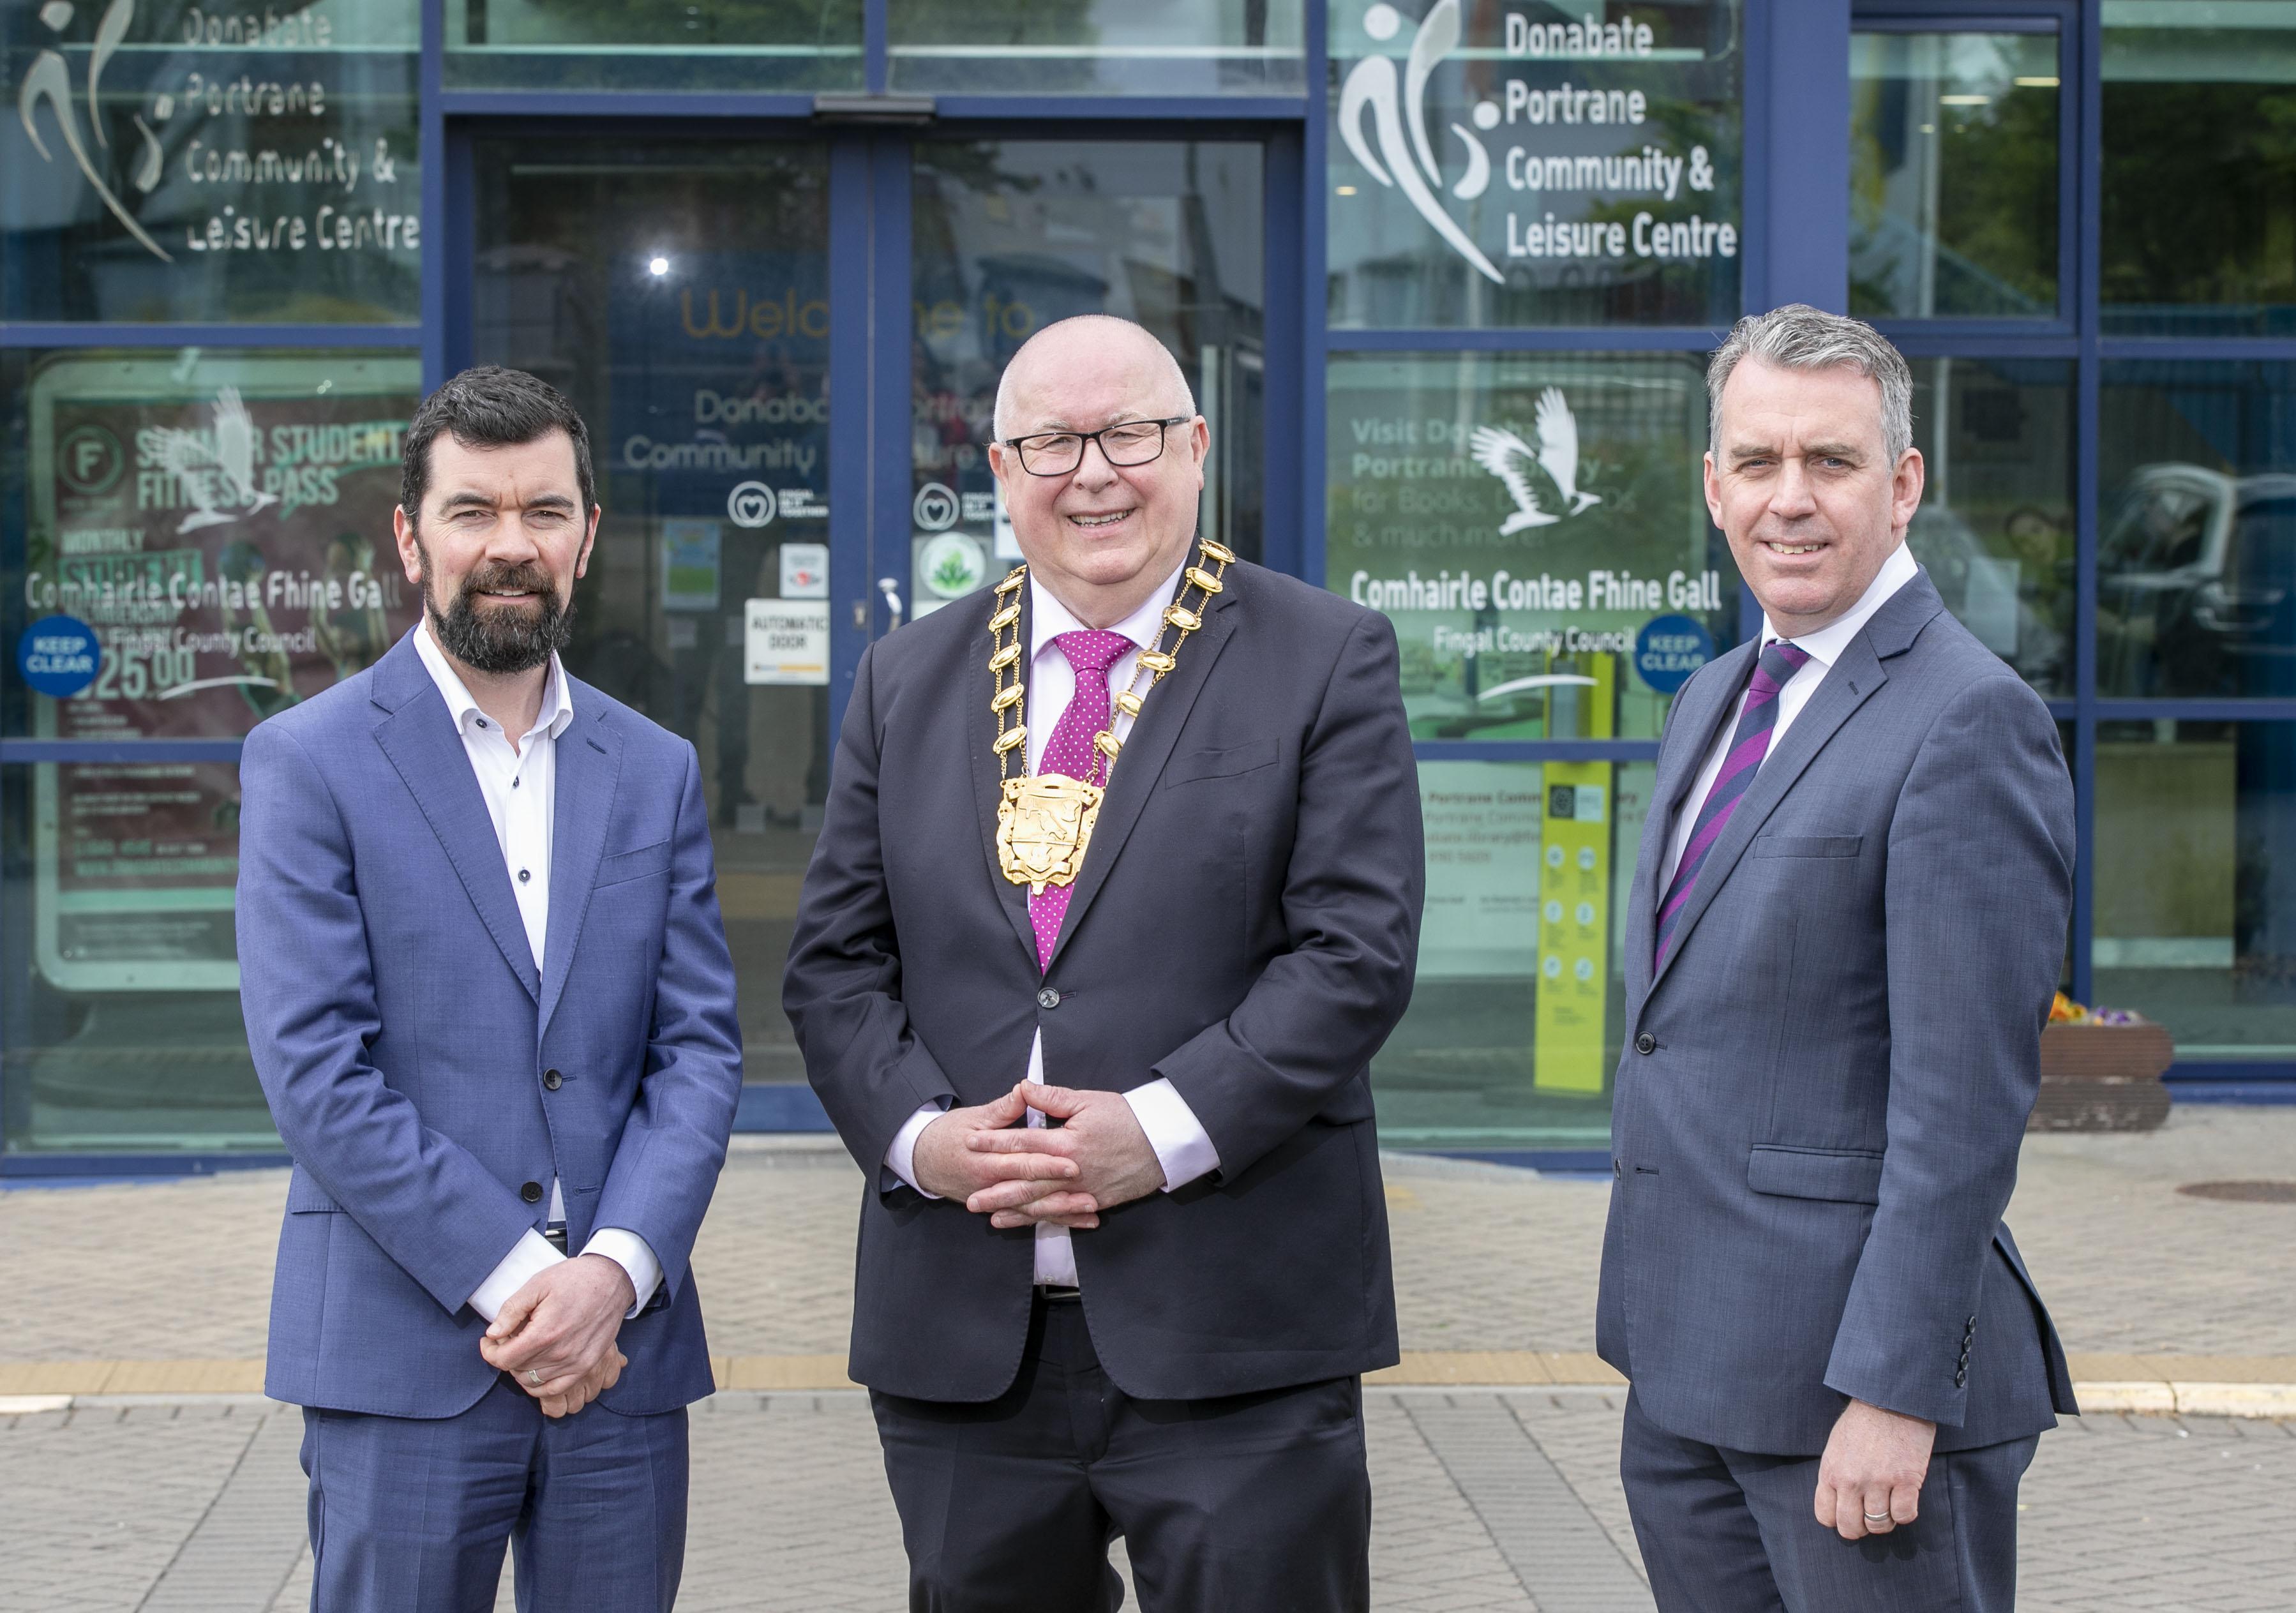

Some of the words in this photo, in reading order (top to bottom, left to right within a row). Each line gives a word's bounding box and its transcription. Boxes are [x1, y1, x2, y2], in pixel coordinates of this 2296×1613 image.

[1505, 12, 1654, 57] Donabate
[184, 71, 326, 116] Portrane
[1506, 79, 1647, 125] Portrane
[186, 138, 360, 192] Community
[371, 138, 397, 183] &
[1506, 146, 1684, 201] Community
[1688, 145, 1715, 191] &
[186, 205, 307, 251] Leisure
[316, 205, 421, 250] Centre
[1506, 211, 1626, 258] Leisure
[1632, 211, 1737, 258] Centre
[984, 293, 1035, 338] to
[270, 421, 405, 465] STUDENT
[1351, 419, 1416, 445] Visit
[624, 434, 816, 477] Community
[263, 466, 340, 506] PASS
[26, 573, 161, 611] Comhairle
[169, 573, 261, 611] Contae
[267, 572, 342, 610] Fhine
[348, 571, 402, 610] Gall
[1351, 571, 1488, 610] Comhairle
[1492, 571, 1583, 610] Contae
[1589, 571, 1663, 610] Fhine
[1668, 571, 1722, 610] Gall
[109, 626, 170, 660] Fingal
[174, 626, 241, 660] County
[243, 626, 317, 654] Council
[752, 615, 829, 632] AUTOMATIC
[769, 633, 807, 650] DOOR
[1434, 626, 1494, 659] Fingal
[1497, 626, 1563, 657] County
[1565, 626, 1639, 653] Council
[1648, 634, 1700, 652] KEEP
[26, 655, 94, 673] CLEAR
[33, 636, 87, 655] KEEP
[1640, 653, 1706, 672] CLEAR
